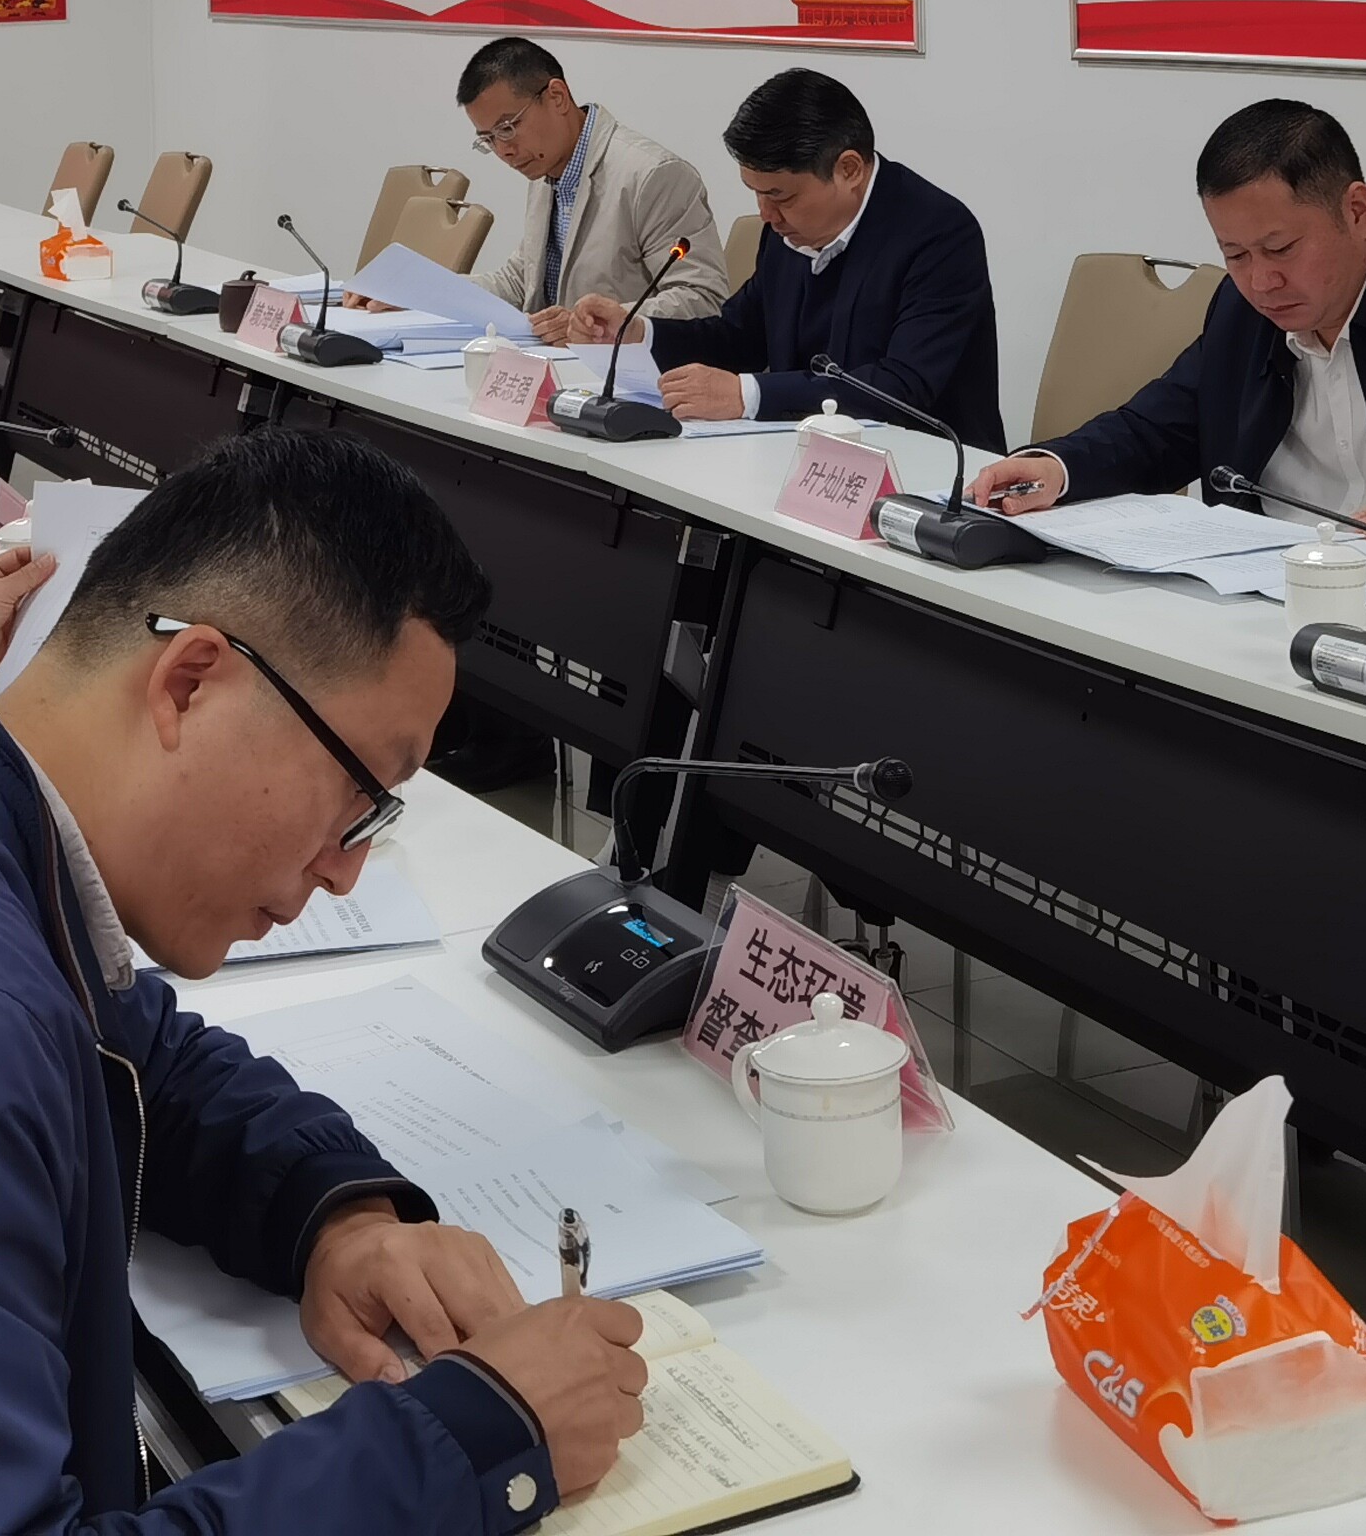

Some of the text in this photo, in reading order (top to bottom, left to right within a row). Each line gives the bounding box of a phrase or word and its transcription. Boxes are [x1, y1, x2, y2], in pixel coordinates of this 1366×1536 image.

[486, 369, 534, 405] 梁志强
[798, 461, 868, 509] 叶灿辉
[697, 988, 780, 1064] 督查
[1083, 1349, 1145, 1418] C&S
